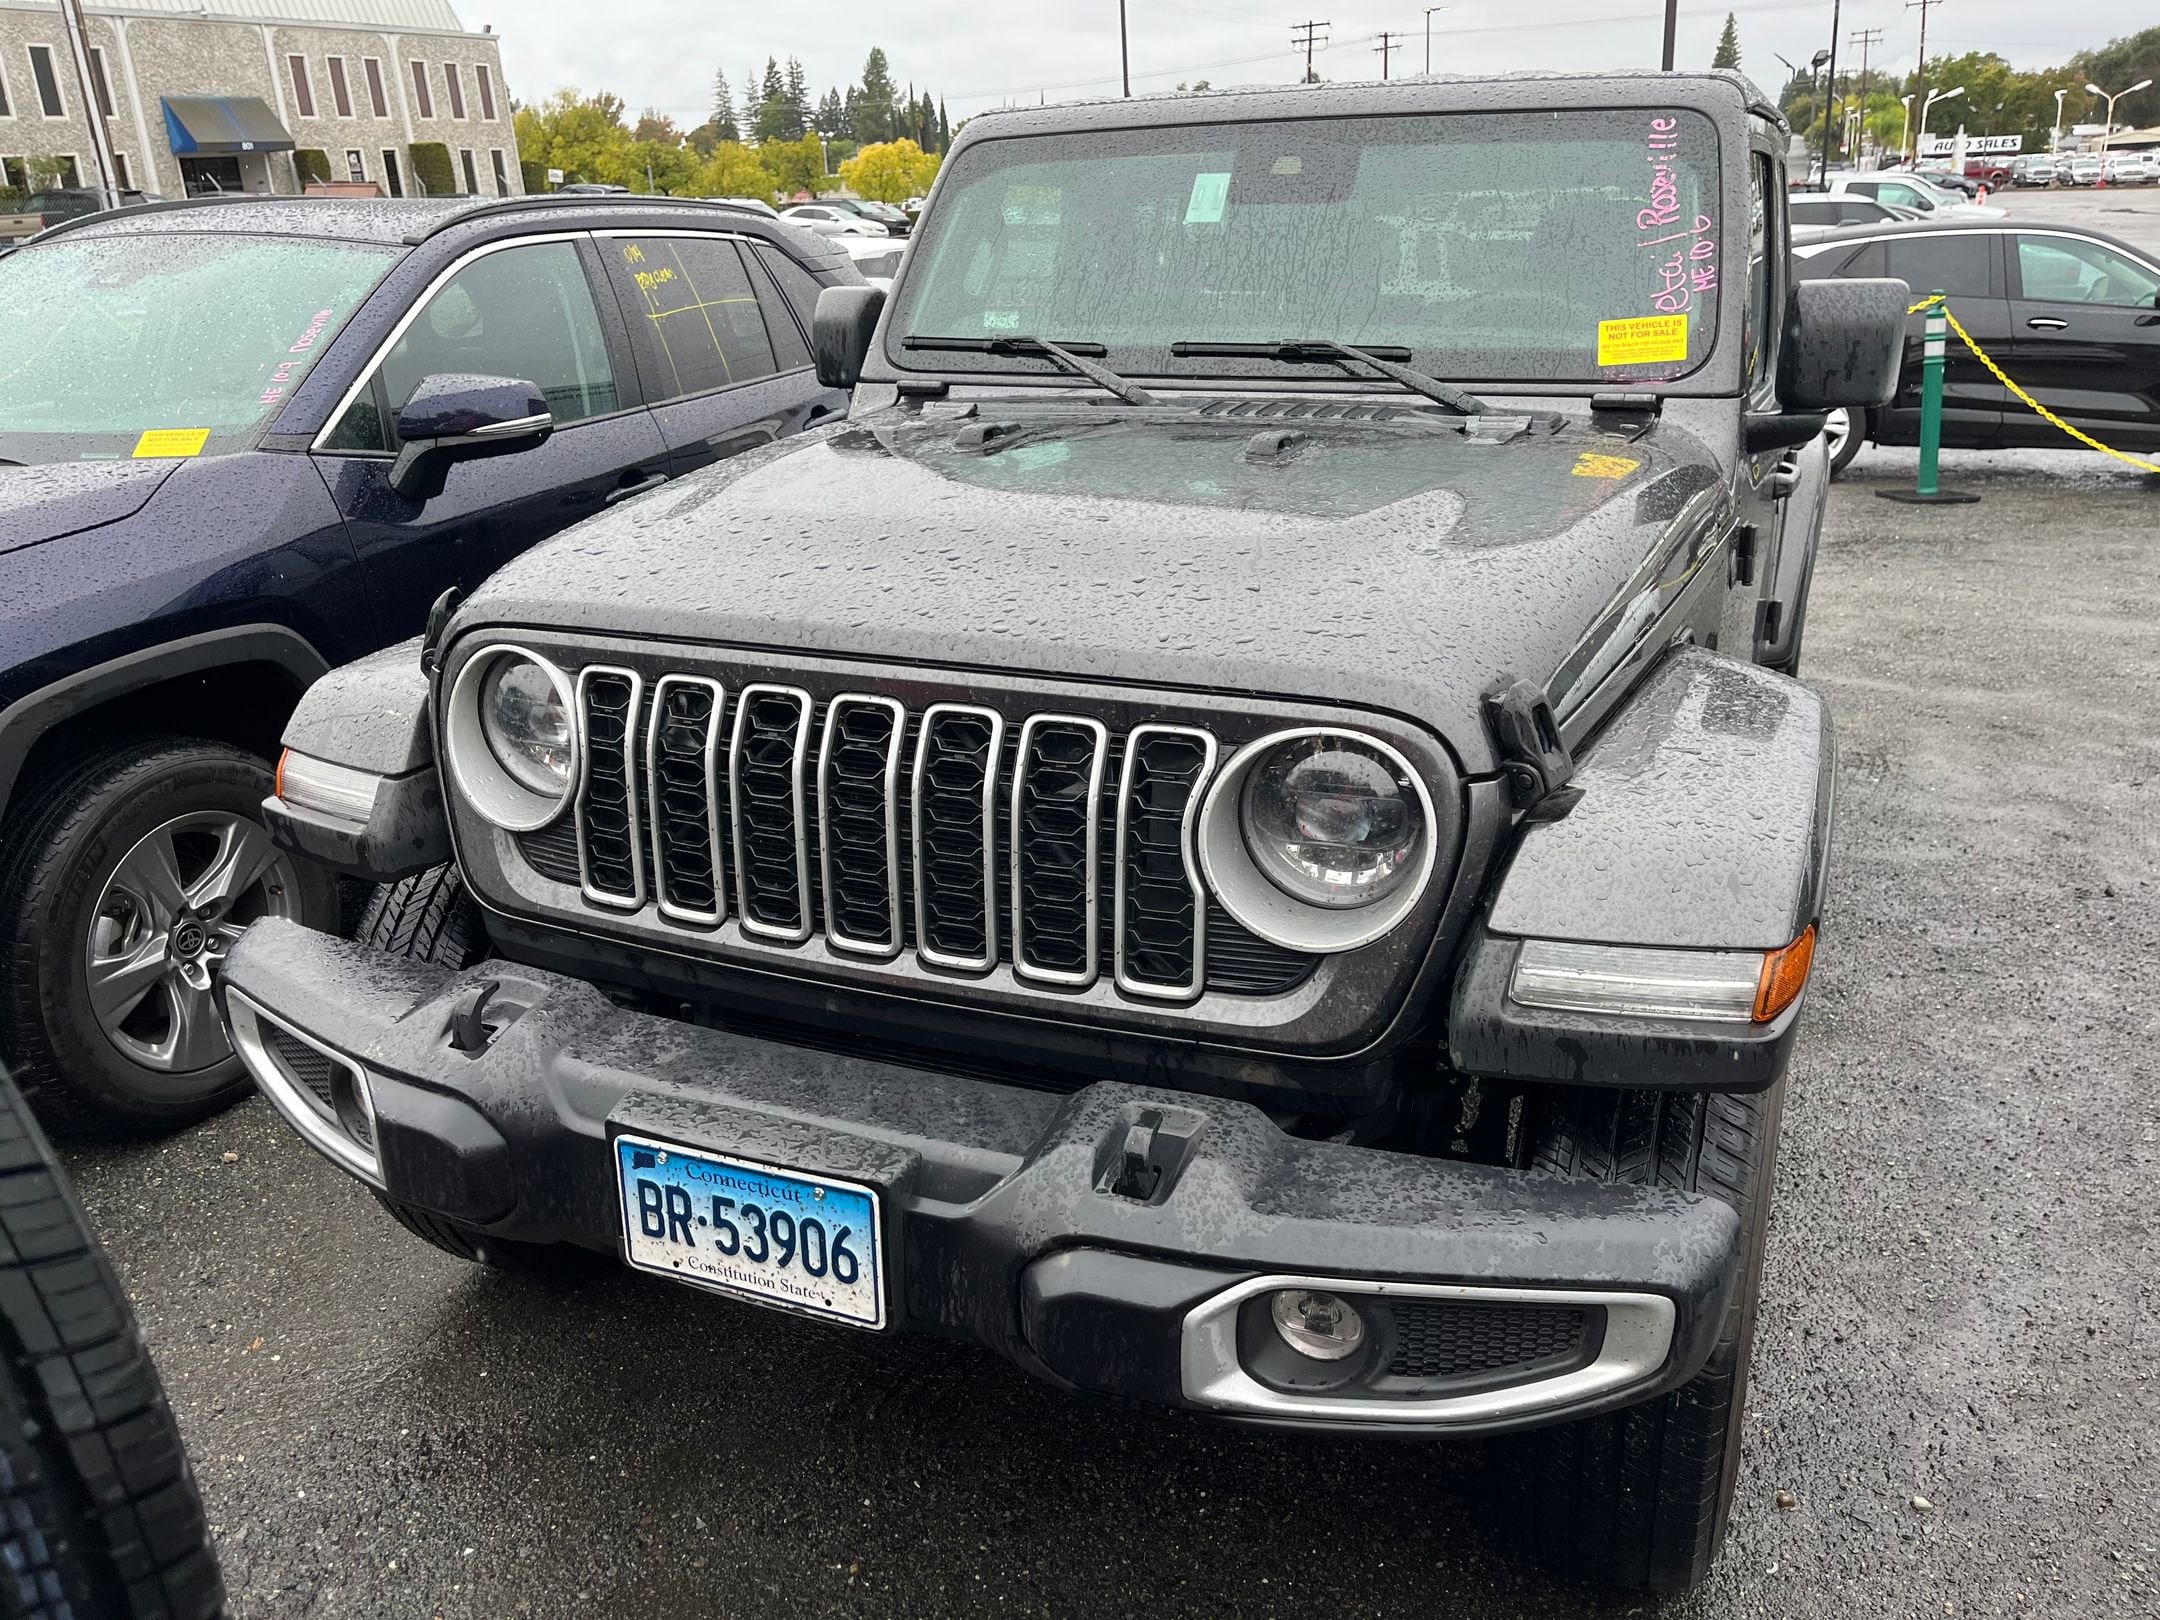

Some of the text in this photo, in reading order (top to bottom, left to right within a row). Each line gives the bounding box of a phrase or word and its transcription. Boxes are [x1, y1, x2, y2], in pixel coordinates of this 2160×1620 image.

[1934, 140, 1972, 152] AUO
[1605, 319, 1682, 332] THIS VEHICLE IS
[1608, 328, 1678, 341] NOT FOR SALE
[686, 1162, 801, 1203] Connecticut
[687, 1256, 817, 1300] Constitution State
